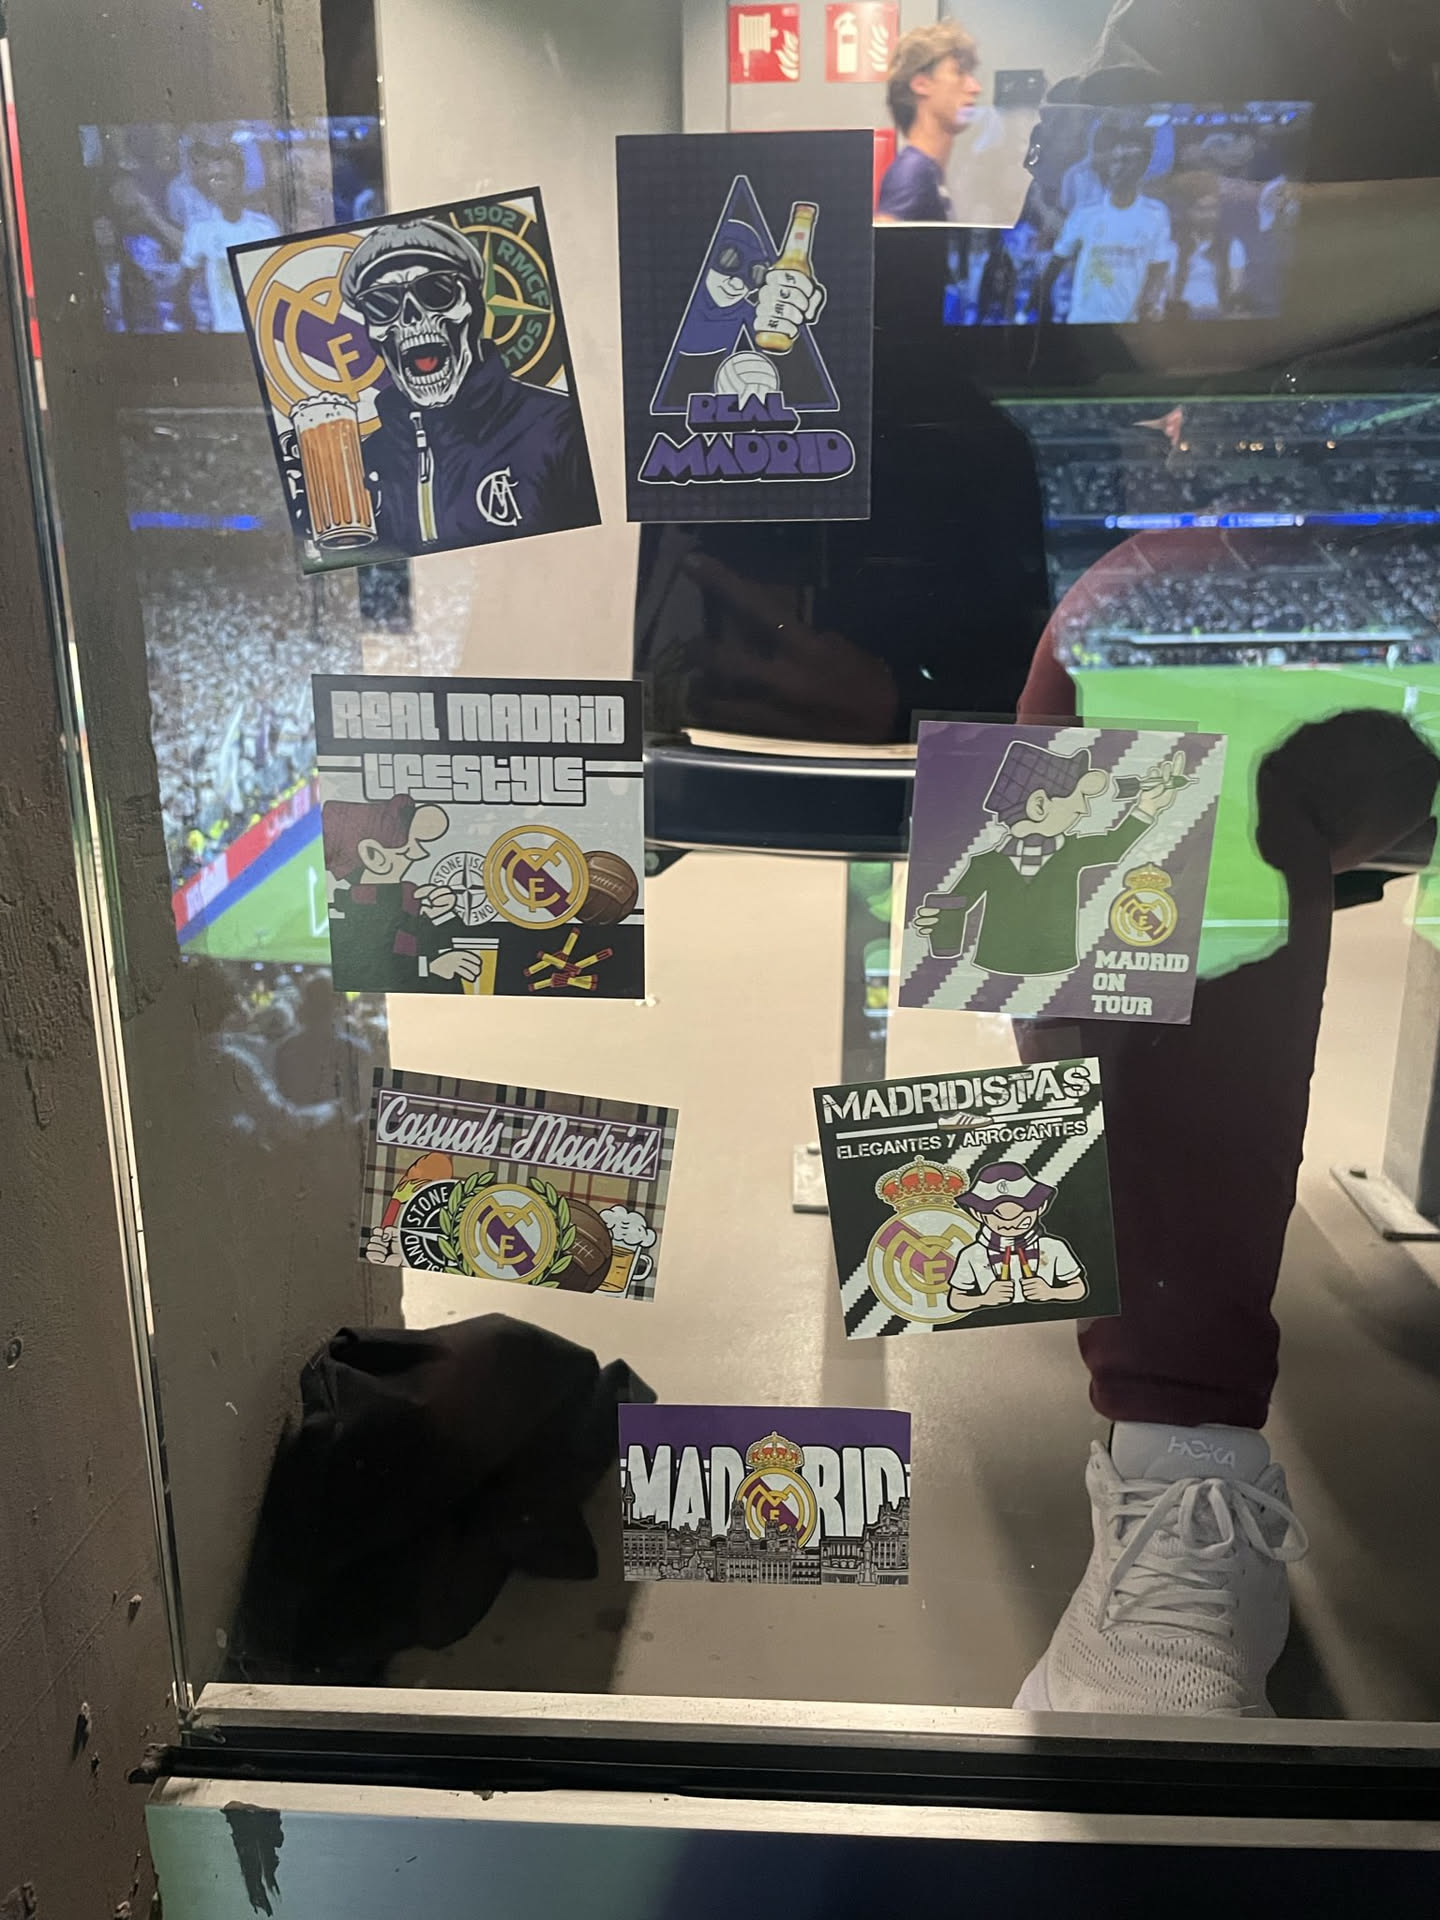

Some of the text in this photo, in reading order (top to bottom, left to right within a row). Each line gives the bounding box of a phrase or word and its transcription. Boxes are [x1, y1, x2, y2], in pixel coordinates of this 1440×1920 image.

[464, 205, 518, 230] 1902
[498, 239, 550, 306] RMCF
[687, 393, 799, 431] REAL
[640, 431, 854, 483] MADRID
[434, 856, 462, 885] STONE
[1095, 950, 1189, 972] MADRID
[1092, 973, 1126, 992] ON
[1091, 995, 1153, 1016] TOUR
[822, 1066, 1091, 1124] MADRIDISTAS
[378, 1096, 659, 1176] Casuals Madrid
[837, 1135, 942, 1160] ELEGANTES
[963, 1120, 1087, 1148] ARROGANTES
[407, 1187, 449, 1226] STONE
[627, 1445, 907, 1548] MADRID
